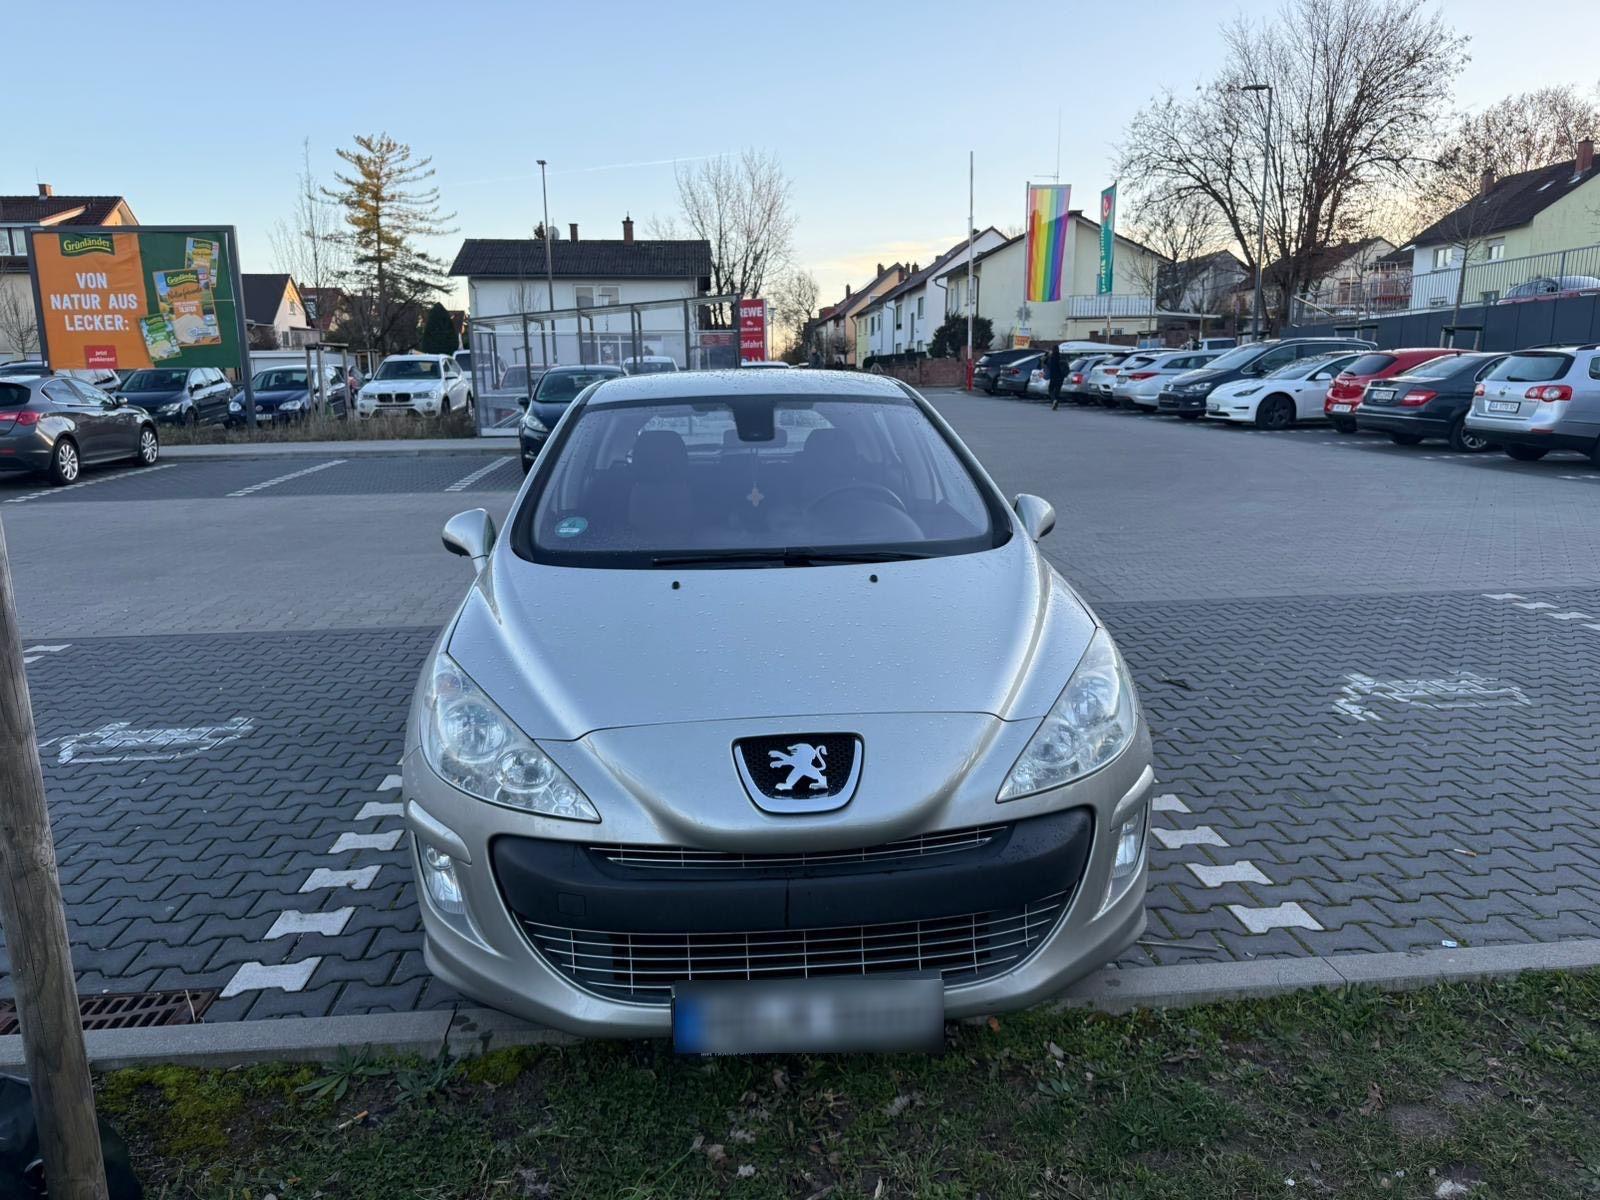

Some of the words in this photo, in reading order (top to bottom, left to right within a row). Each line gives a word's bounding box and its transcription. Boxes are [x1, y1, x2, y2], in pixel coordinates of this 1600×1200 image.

[75, 272, 107, 289] VON
[50, 294, 101, 310] NATUR
[108, 294, 138, 310] AUS
[64, 315, 129, 331] LECKER:
